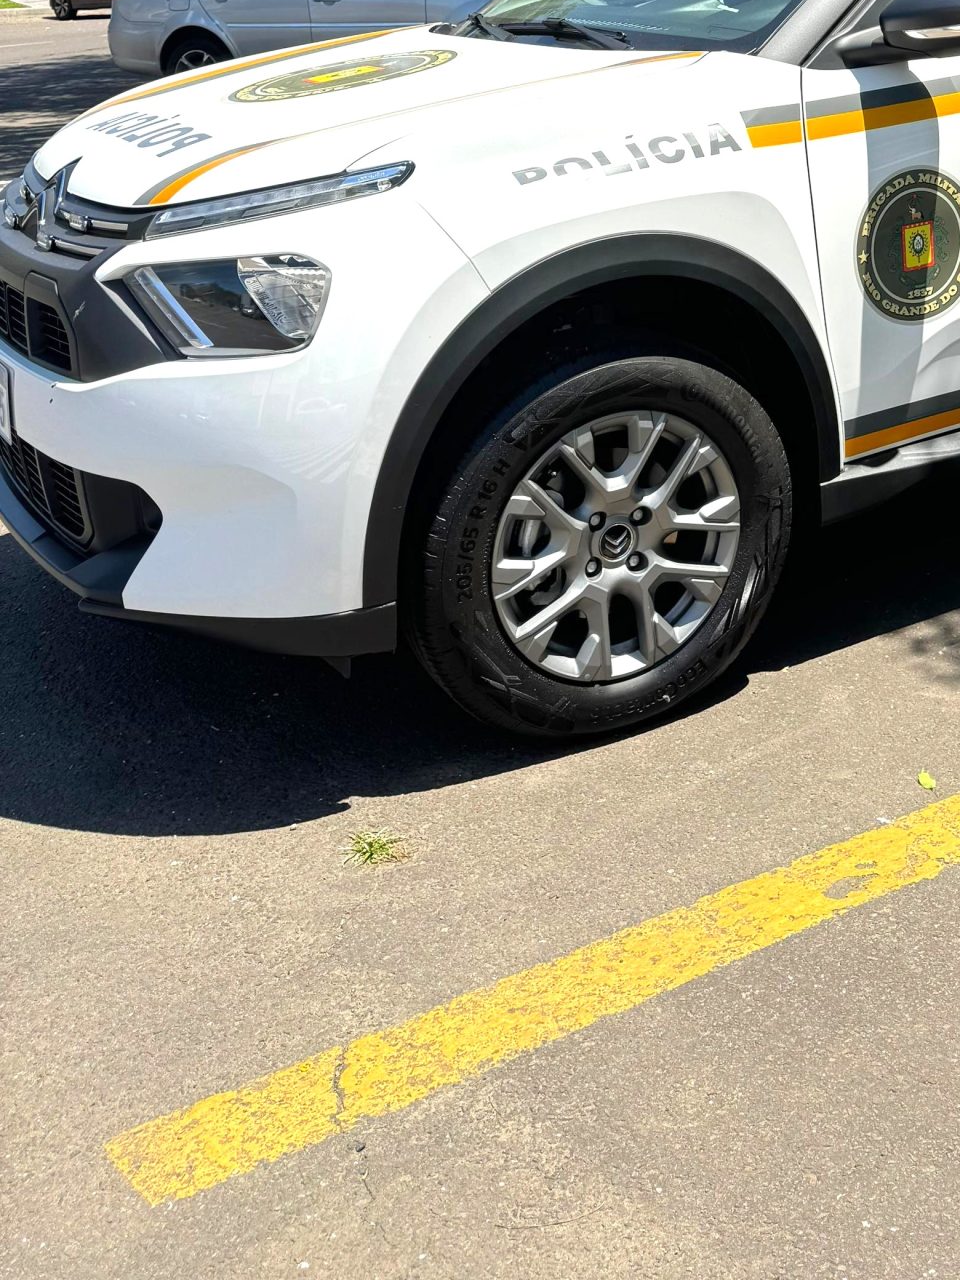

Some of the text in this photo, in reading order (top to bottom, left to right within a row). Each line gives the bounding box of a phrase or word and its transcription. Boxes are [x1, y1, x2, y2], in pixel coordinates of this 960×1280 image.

[861, 174, 916, 237] BRIGADA
[862, 271, 882, 302] RIO
[881, 299, 940, 316] GRANDE
[941, 283, 959, 305] DO
[907, 286, 935, 299] 1837
[492, 458, 511, 477] H
[478, 478, 499, 501] 16
[469, 504, 488, 520] R
[456, 526, 480, 604] 205/65
